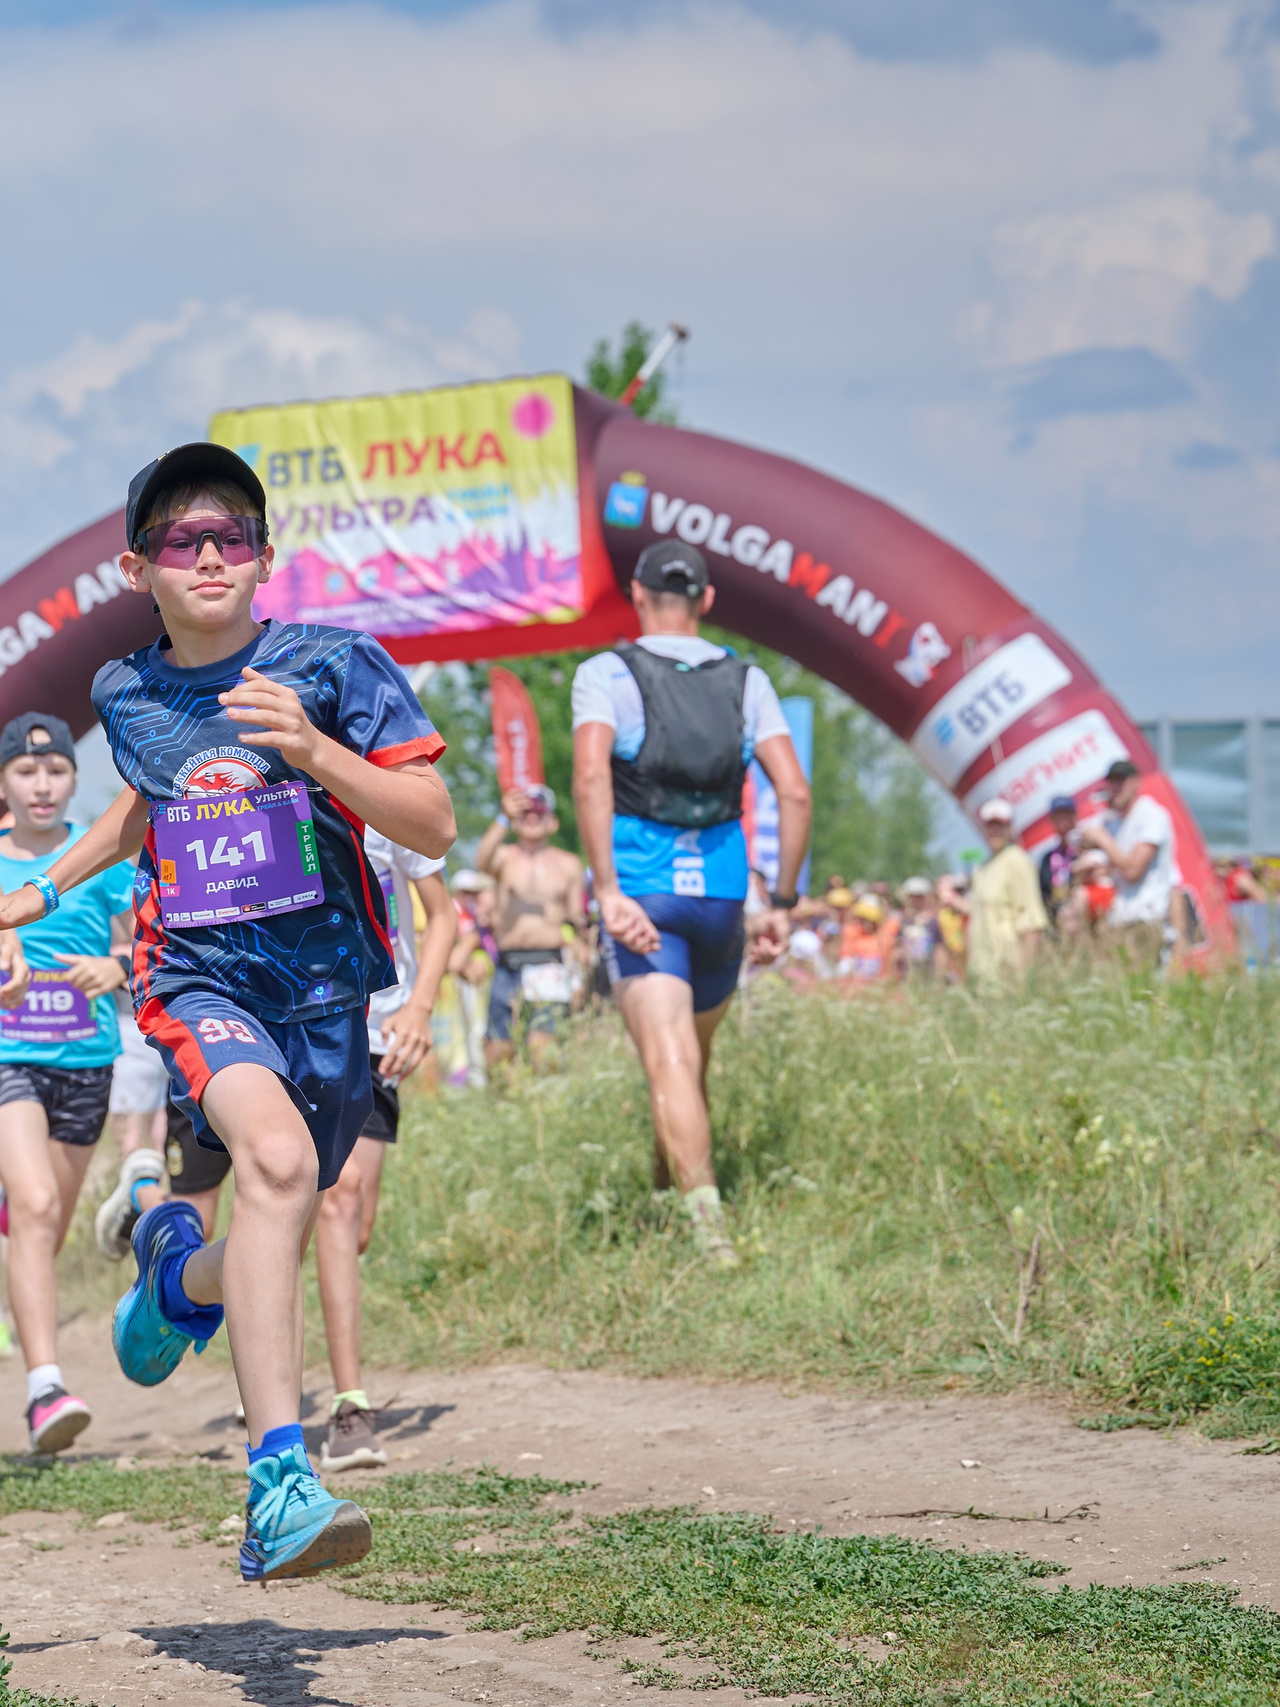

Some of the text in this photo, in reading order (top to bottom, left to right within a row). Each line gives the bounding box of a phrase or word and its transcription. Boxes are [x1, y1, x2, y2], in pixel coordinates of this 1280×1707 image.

[267, 430, 506, 488] ВТБ ЛУКА
[958, 670, 1025, 736] ВТБ
[173, 746, 271, 797] ХОККЕЙНАЯ КОМАНДА
[167, 788, 299, 822] ВТБ ЛУКА УЛЬТРА
[186, 830, 267, 871] 141
[301, 825, 316, 872] ТРЕЙЛ
[206, 876, 259, 894] ДАВИД
[24, 990, 74, 1012] 119
